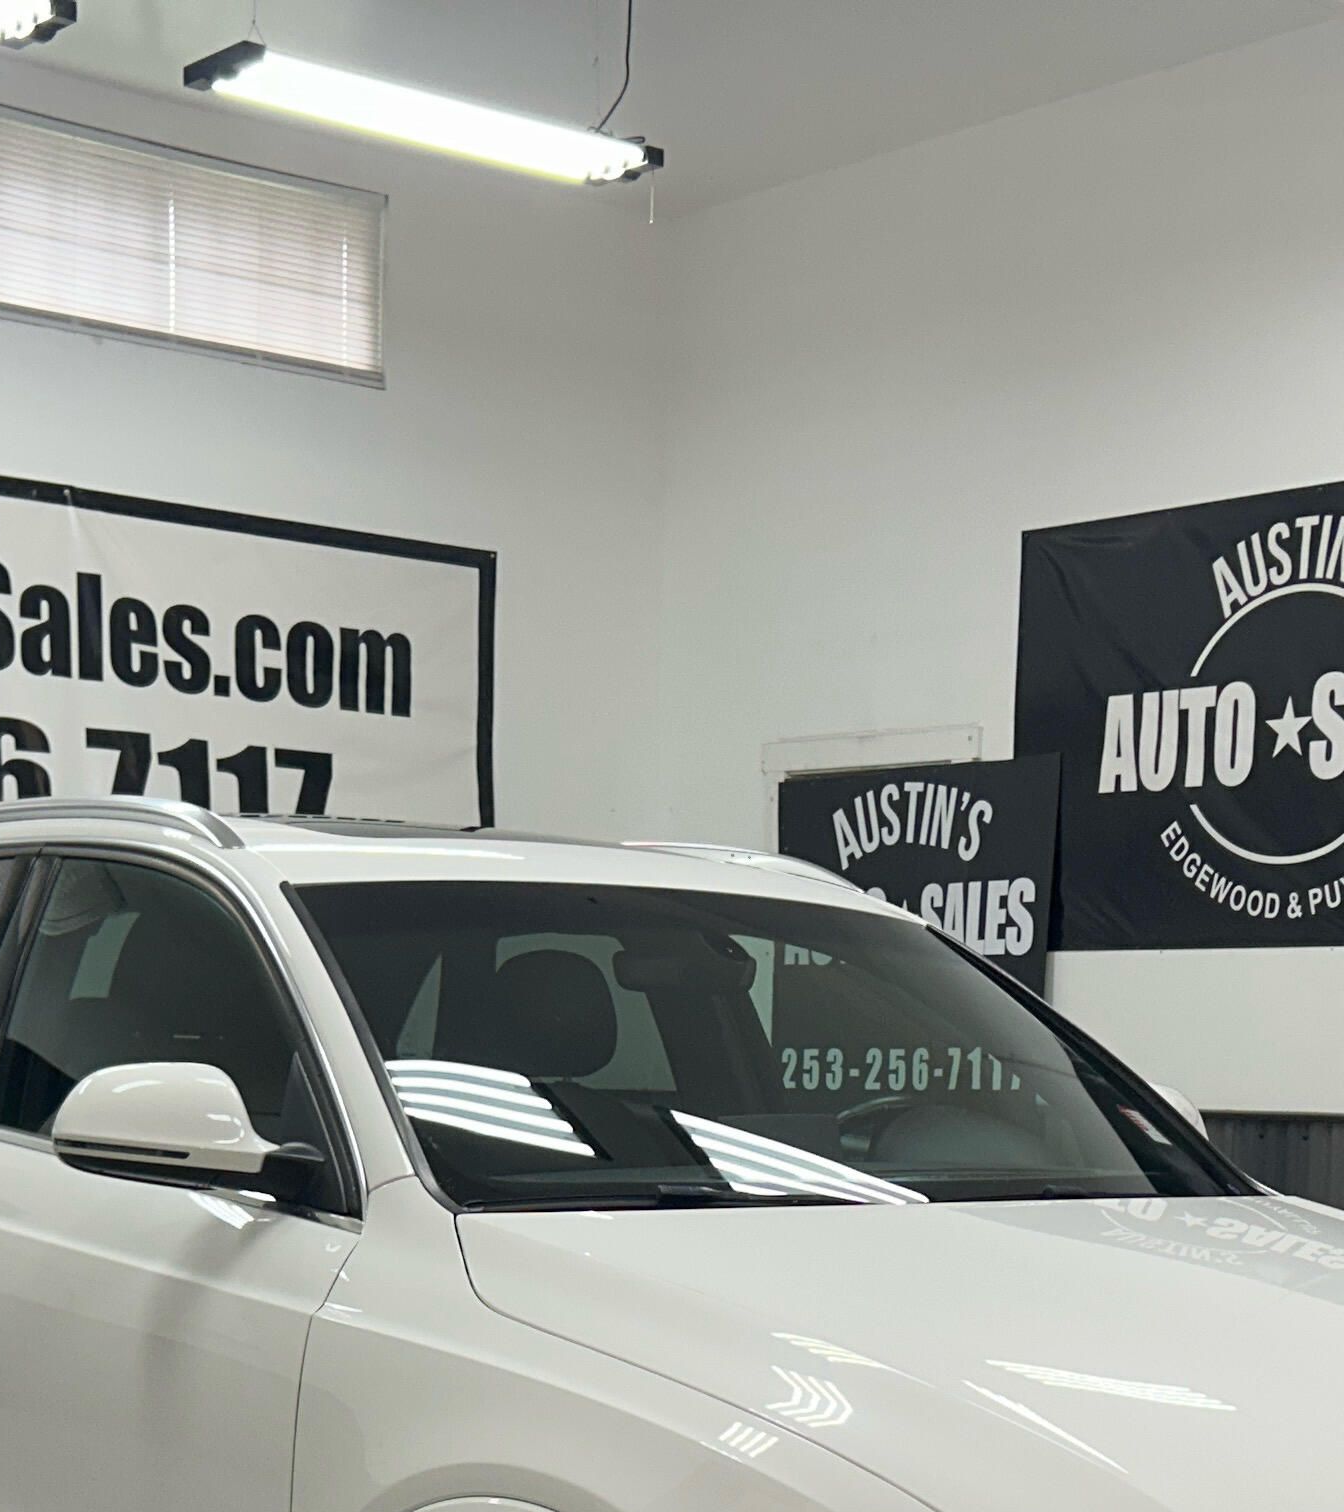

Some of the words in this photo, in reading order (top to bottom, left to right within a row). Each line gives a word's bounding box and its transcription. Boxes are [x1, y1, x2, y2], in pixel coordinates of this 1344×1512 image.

[1098, 681, 1256, 794] AUTO
[832, 782, 993, 871] AUSTIN'S
[1160, 821, 1281, 920] EDGEWOOD
[1287, 894, 1303, 919] &
